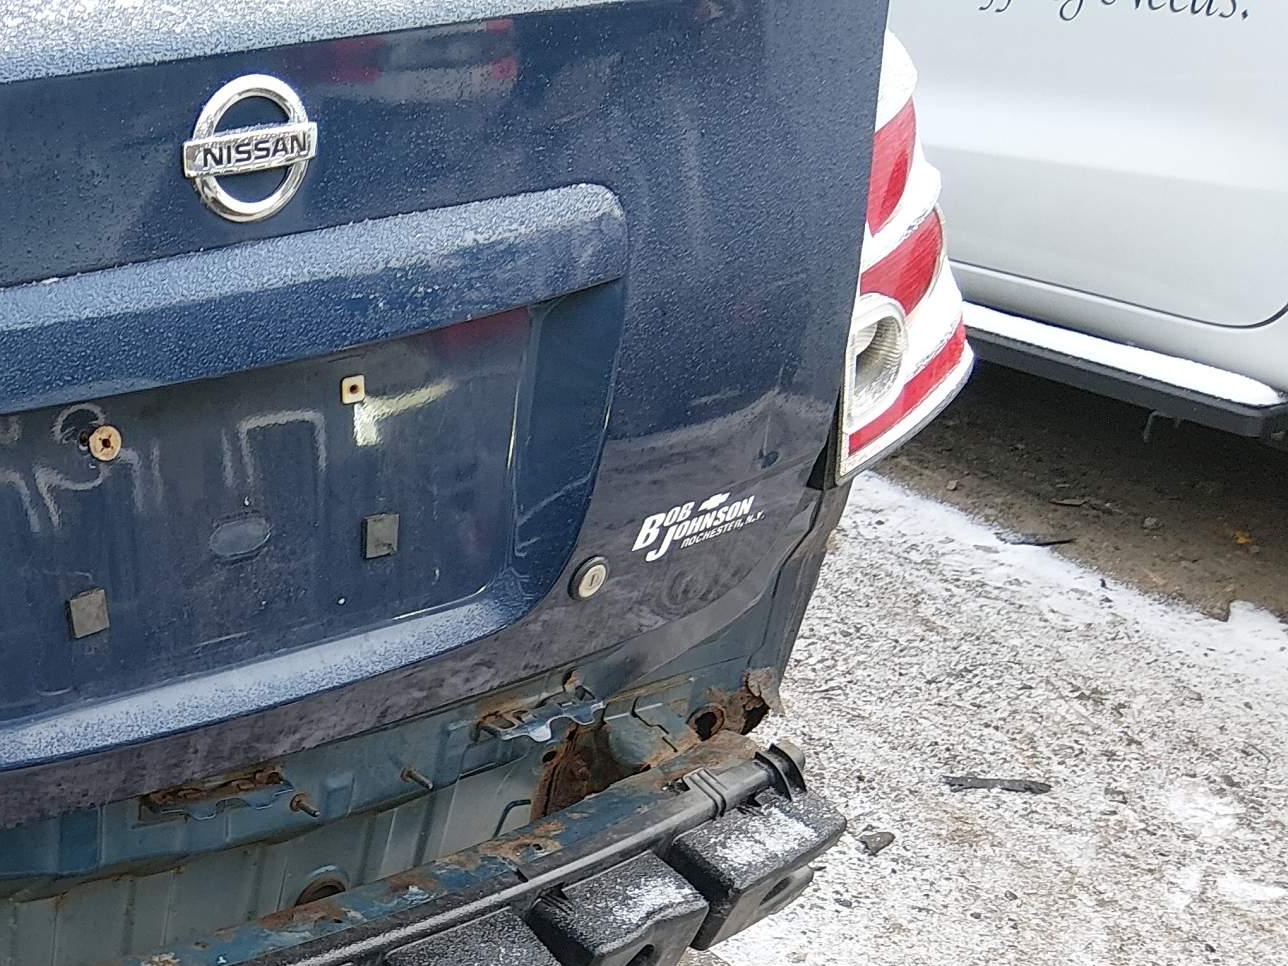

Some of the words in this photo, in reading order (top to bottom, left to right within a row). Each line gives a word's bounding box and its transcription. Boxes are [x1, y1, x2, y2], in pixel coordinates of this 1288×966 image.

[202, 132, 308, 169] NISSAN
[631, 501, 697, 552] BOB
[645, 495, 755, 562] JOHNSON
